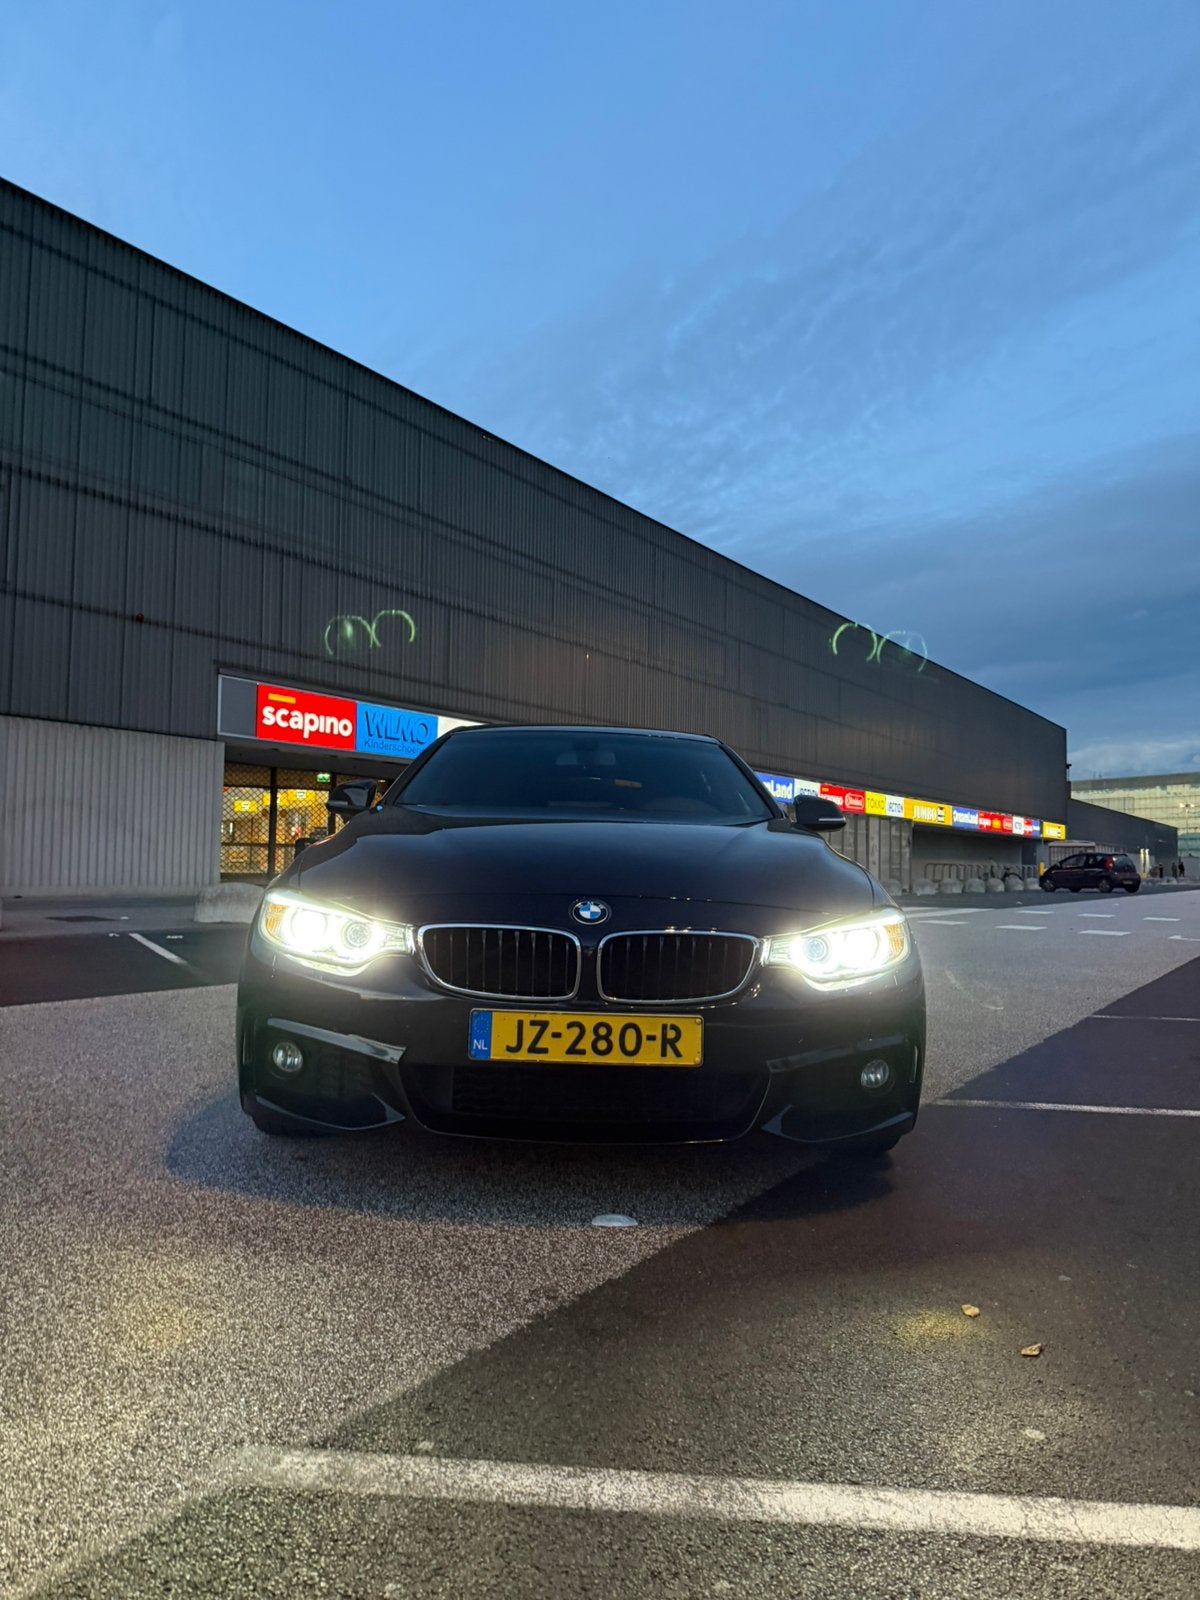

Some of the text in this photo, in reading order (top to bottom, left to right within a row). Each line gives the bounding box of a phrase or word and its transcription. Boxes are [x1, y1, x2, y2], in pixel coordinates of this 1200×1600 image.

[262, 706, 353, 738] scapino
[473, 1040, 488, 1050] NL
[505, 1019, 683, 1058] JZ-280-R
